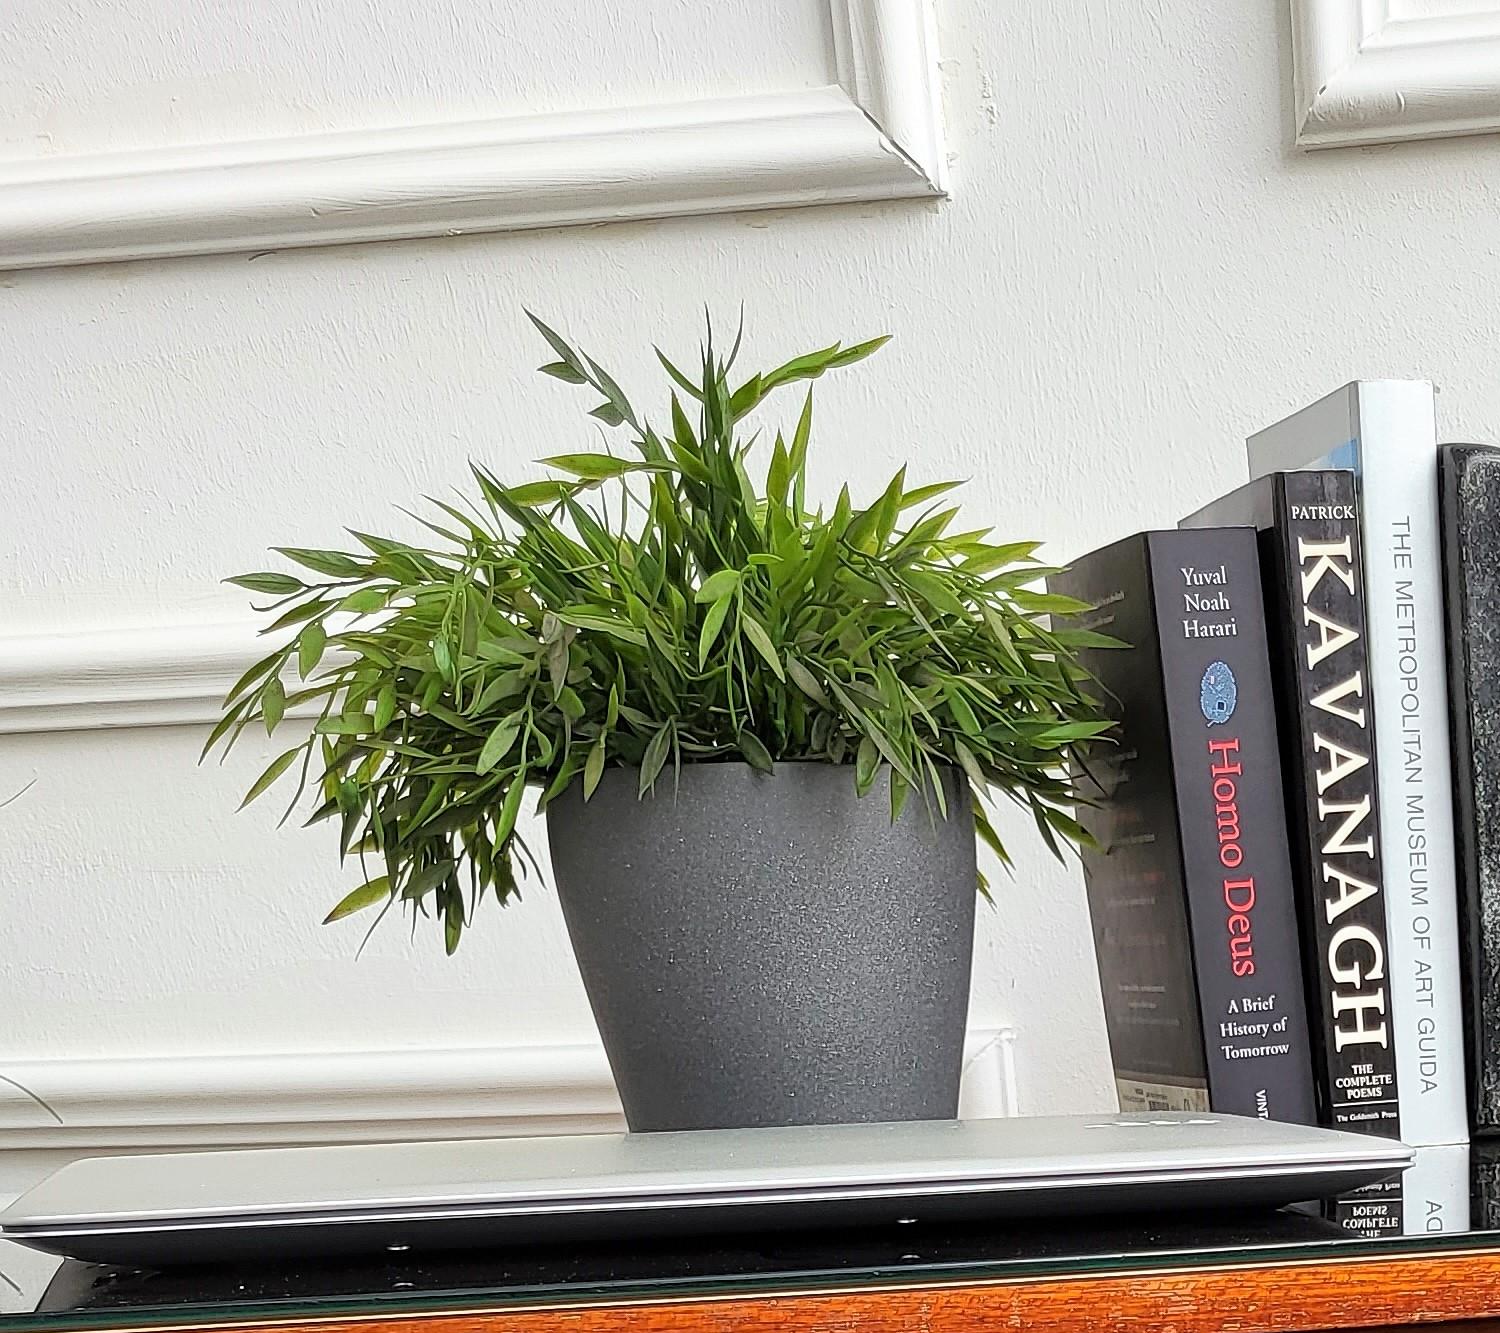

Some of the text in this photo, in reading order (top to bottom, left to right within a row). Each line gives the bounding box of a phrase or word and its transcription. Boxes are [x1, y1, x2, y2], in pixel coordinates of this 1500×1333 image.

[1291, 505, 1355, 520] PATRICK
[1180, 565, 1227, 586] Yuval
[1184, 592, 1231, 611] Noah
[1182, 618, 1237, 638] Harari
[1298, 535, 1388, 1054] KAVANAGH
[1392, 516, 1439, 1094] THE METROPOLITAN MUSEUM OF ART GUIDA
[1208, 738, 1256, 977] Homo Deus
[1228, 995, 1276, 1014] A Brief
[1220, 1017, 1288, 1038] History of
[1221, 1043, 1289, 1060] Tomorrow
[1351, 1064, 1374, 1075] THE
[1335, 1074, 1393, 1089] COMPLETE
[1346, 1086, 1383, 1100] POEMS
